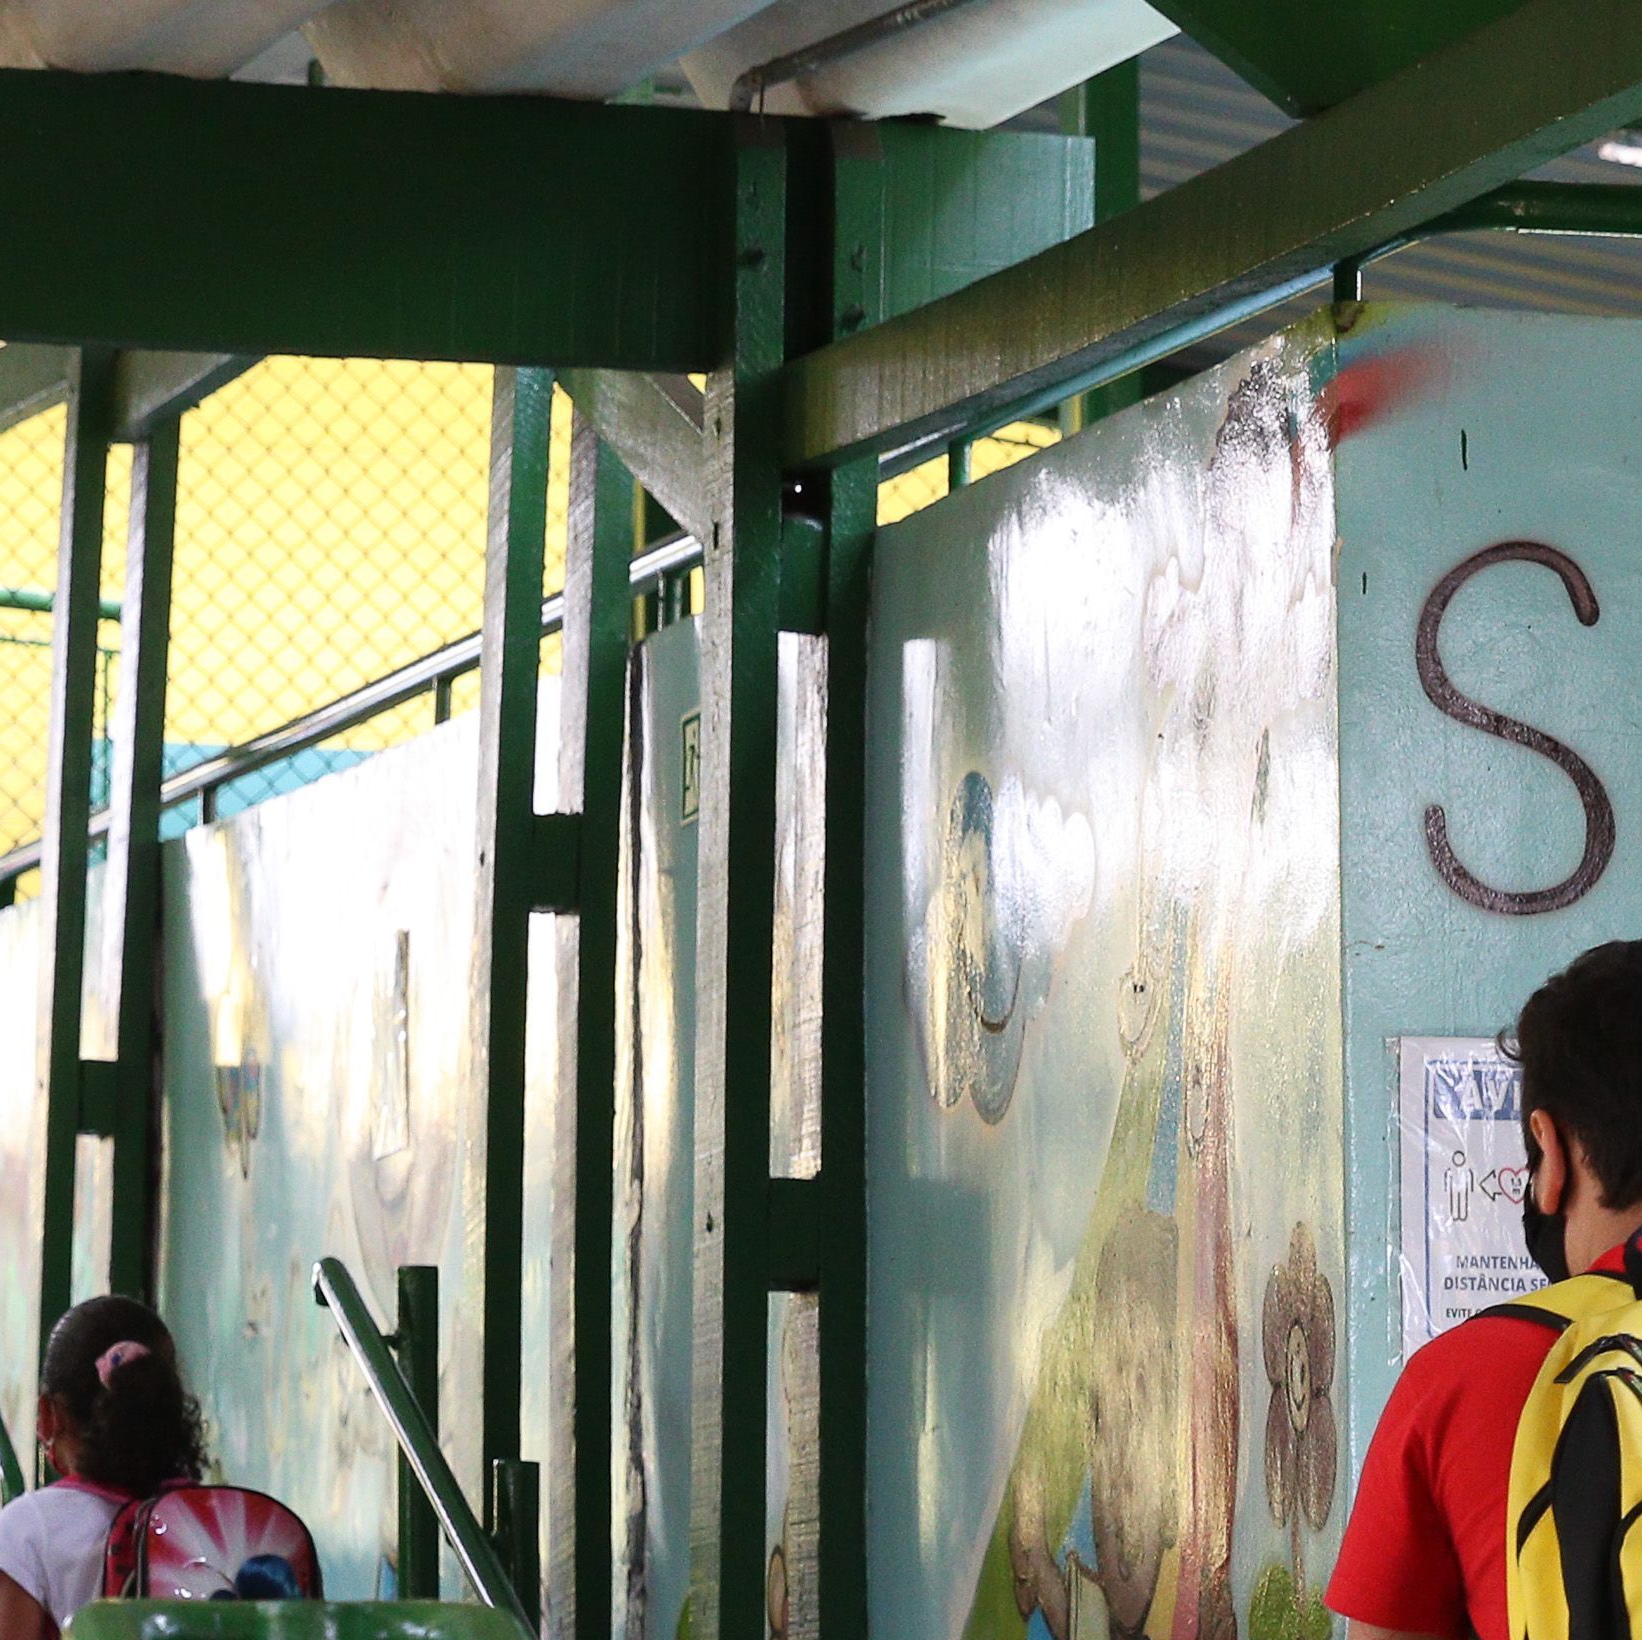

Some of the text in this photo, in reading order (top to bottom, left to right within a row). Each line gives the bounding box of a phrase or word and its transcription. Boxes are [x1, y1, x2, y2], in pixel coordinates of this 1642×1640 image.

[1458, 1078, 1521, 1112] AVI
[1456, 1255, 1541, 1270] MANTENHA
[1444, 1273, 1552, 1292] DISTÂNCIA SE
[1446, 1308, 1472, 1319] EVITE
